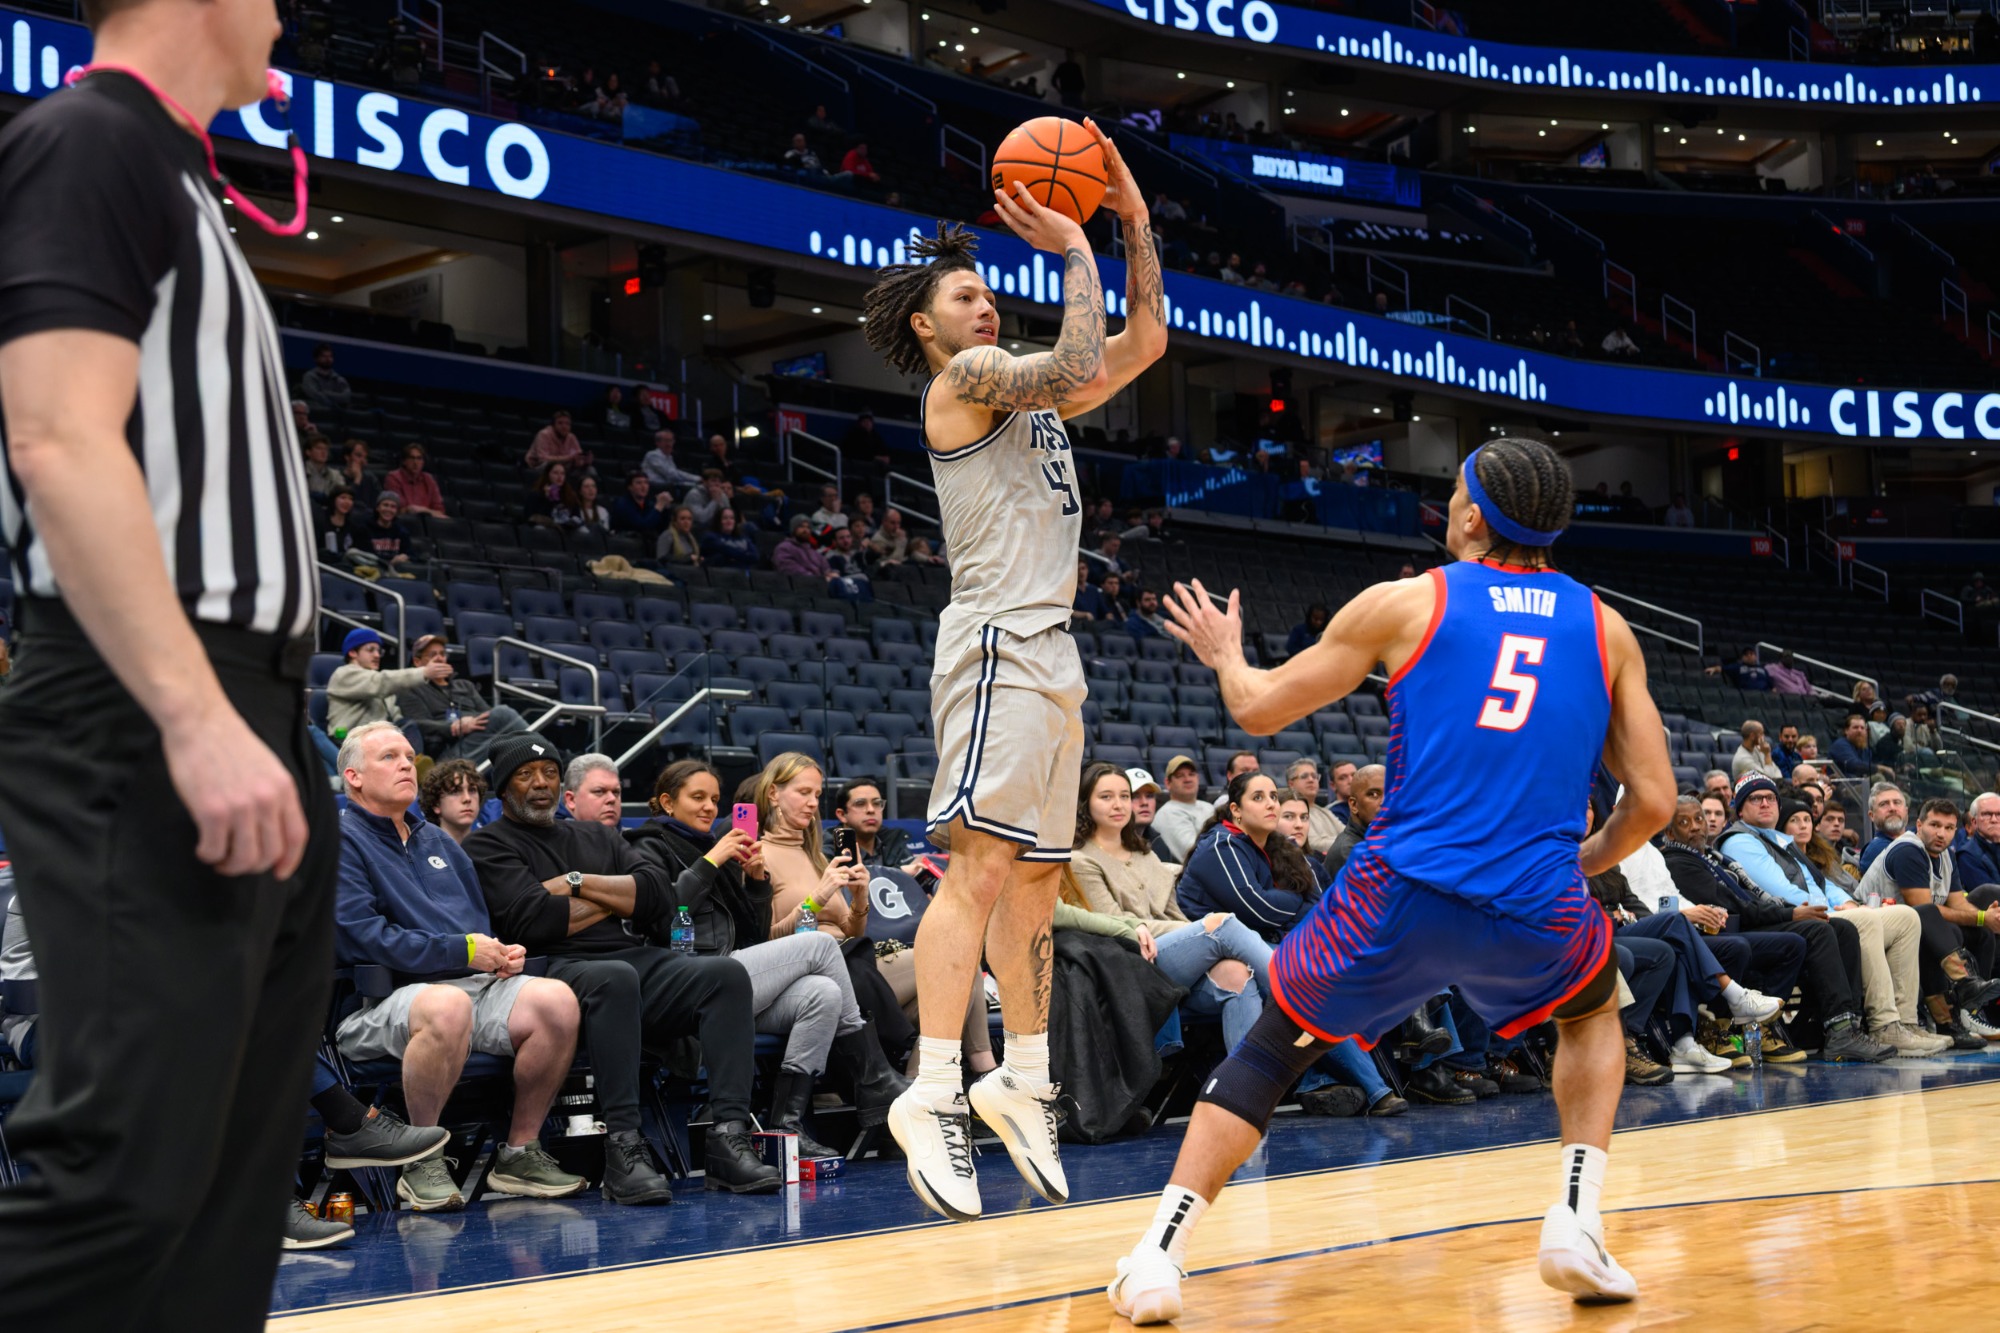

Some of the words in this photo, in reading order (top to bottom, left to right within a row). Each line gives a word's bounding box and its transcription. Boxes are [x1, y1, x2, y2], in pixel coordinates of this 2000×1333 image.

[239, 68, 550, 199] CISCO
[1488, 585, 1557, 618] SMITH
[1475, 632, 1548, 733] 5
[868, 876, 913, 919] G
